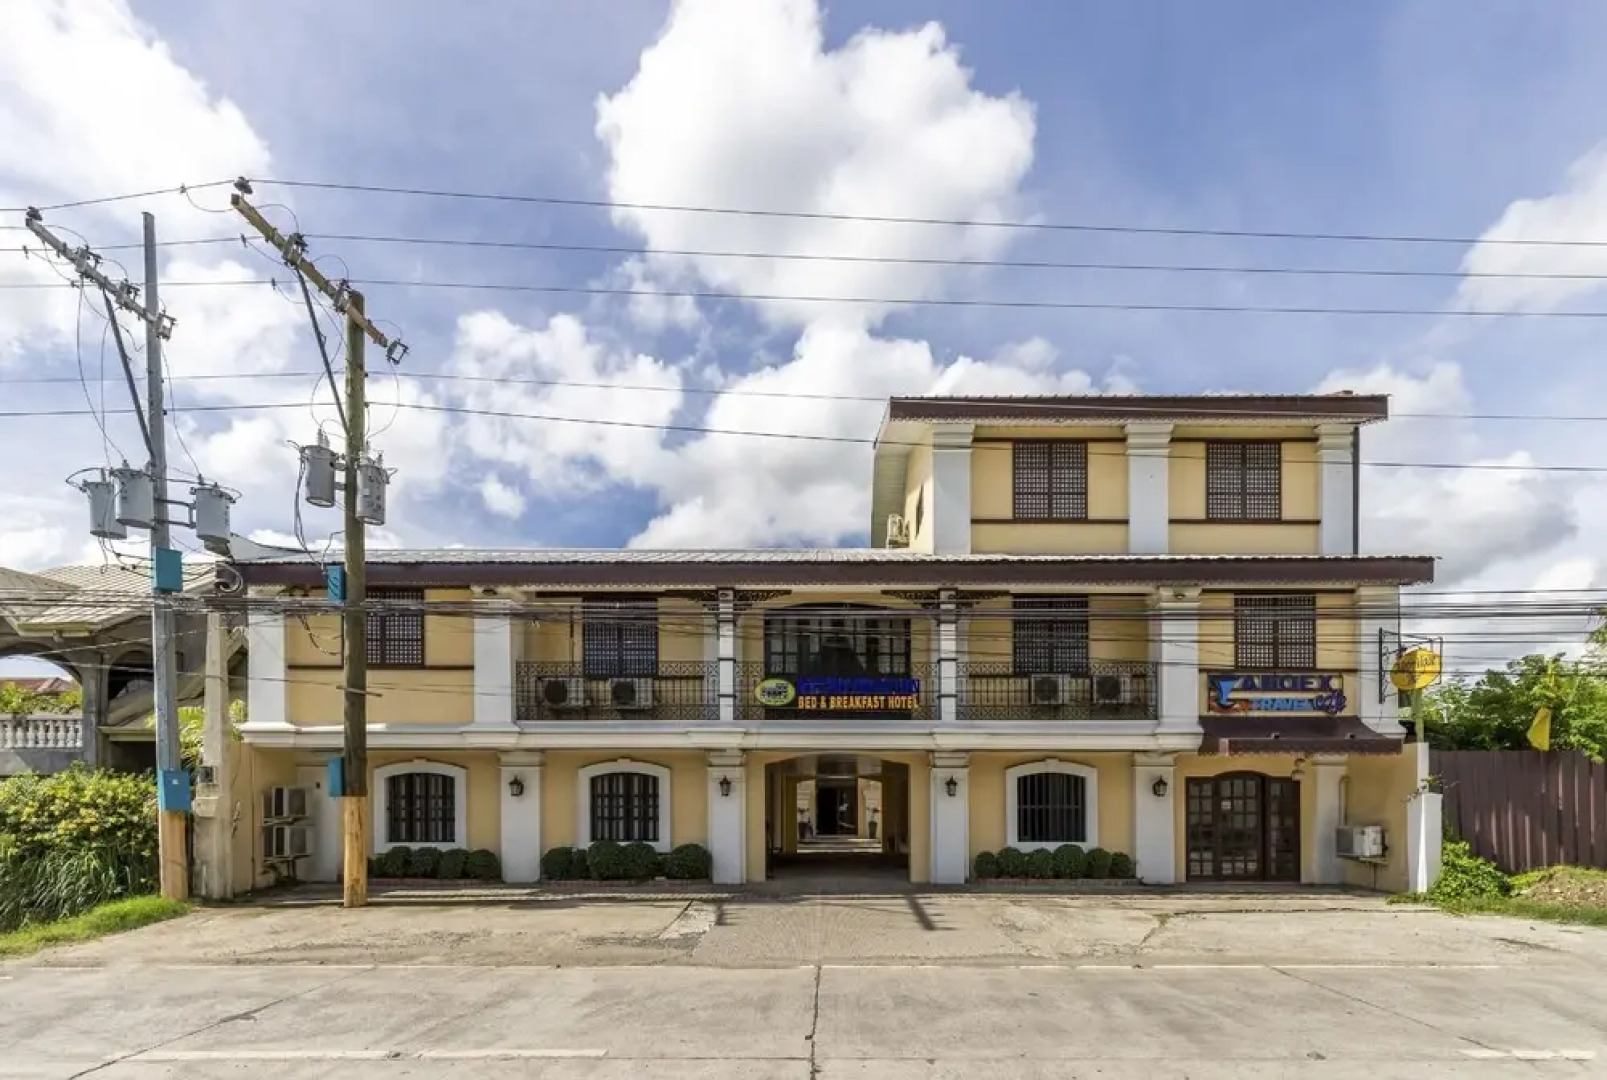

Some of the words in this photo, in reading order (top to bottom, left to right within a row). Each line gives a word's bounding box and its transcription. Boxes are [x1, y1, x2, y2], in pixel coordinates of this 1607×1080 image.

[799, 696, 817, 709] BED
[820, 696, 827, 709] &
[830, 696, 885, 709] BREAKFAST
[888, 695, 919, 709] HOTEL
[1250, 697, 1314, 711] TRAVEL
